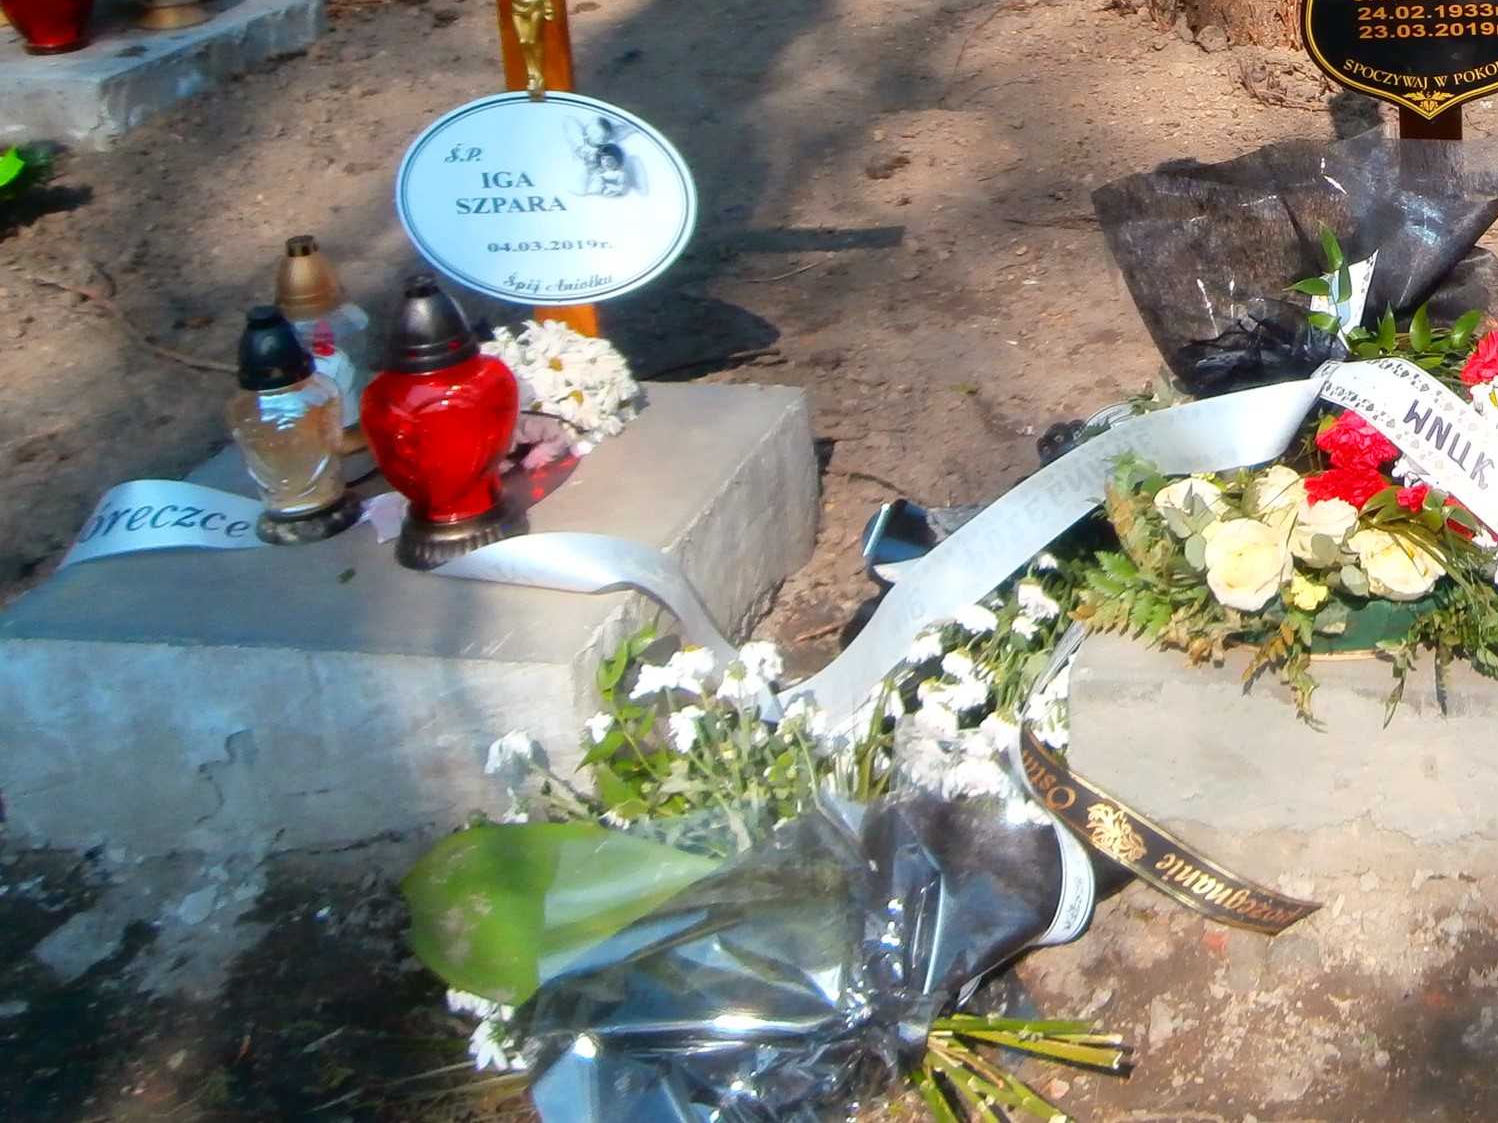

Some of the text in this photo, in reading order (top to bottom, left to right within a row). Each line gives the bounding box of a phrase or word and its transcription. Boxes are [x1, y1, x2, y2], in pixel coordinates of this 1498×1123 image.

[1343, 58, 1430, 90] SPOCZYWAJ
[1434, 75, 1448, 88] W
[481, 171, 535, 189] IGA
[455, 196, 568, 215] SZPARA
[487, 239, 614, 254] 04.03.2019r.
[1402, 398, 1497, 490] WNUK
